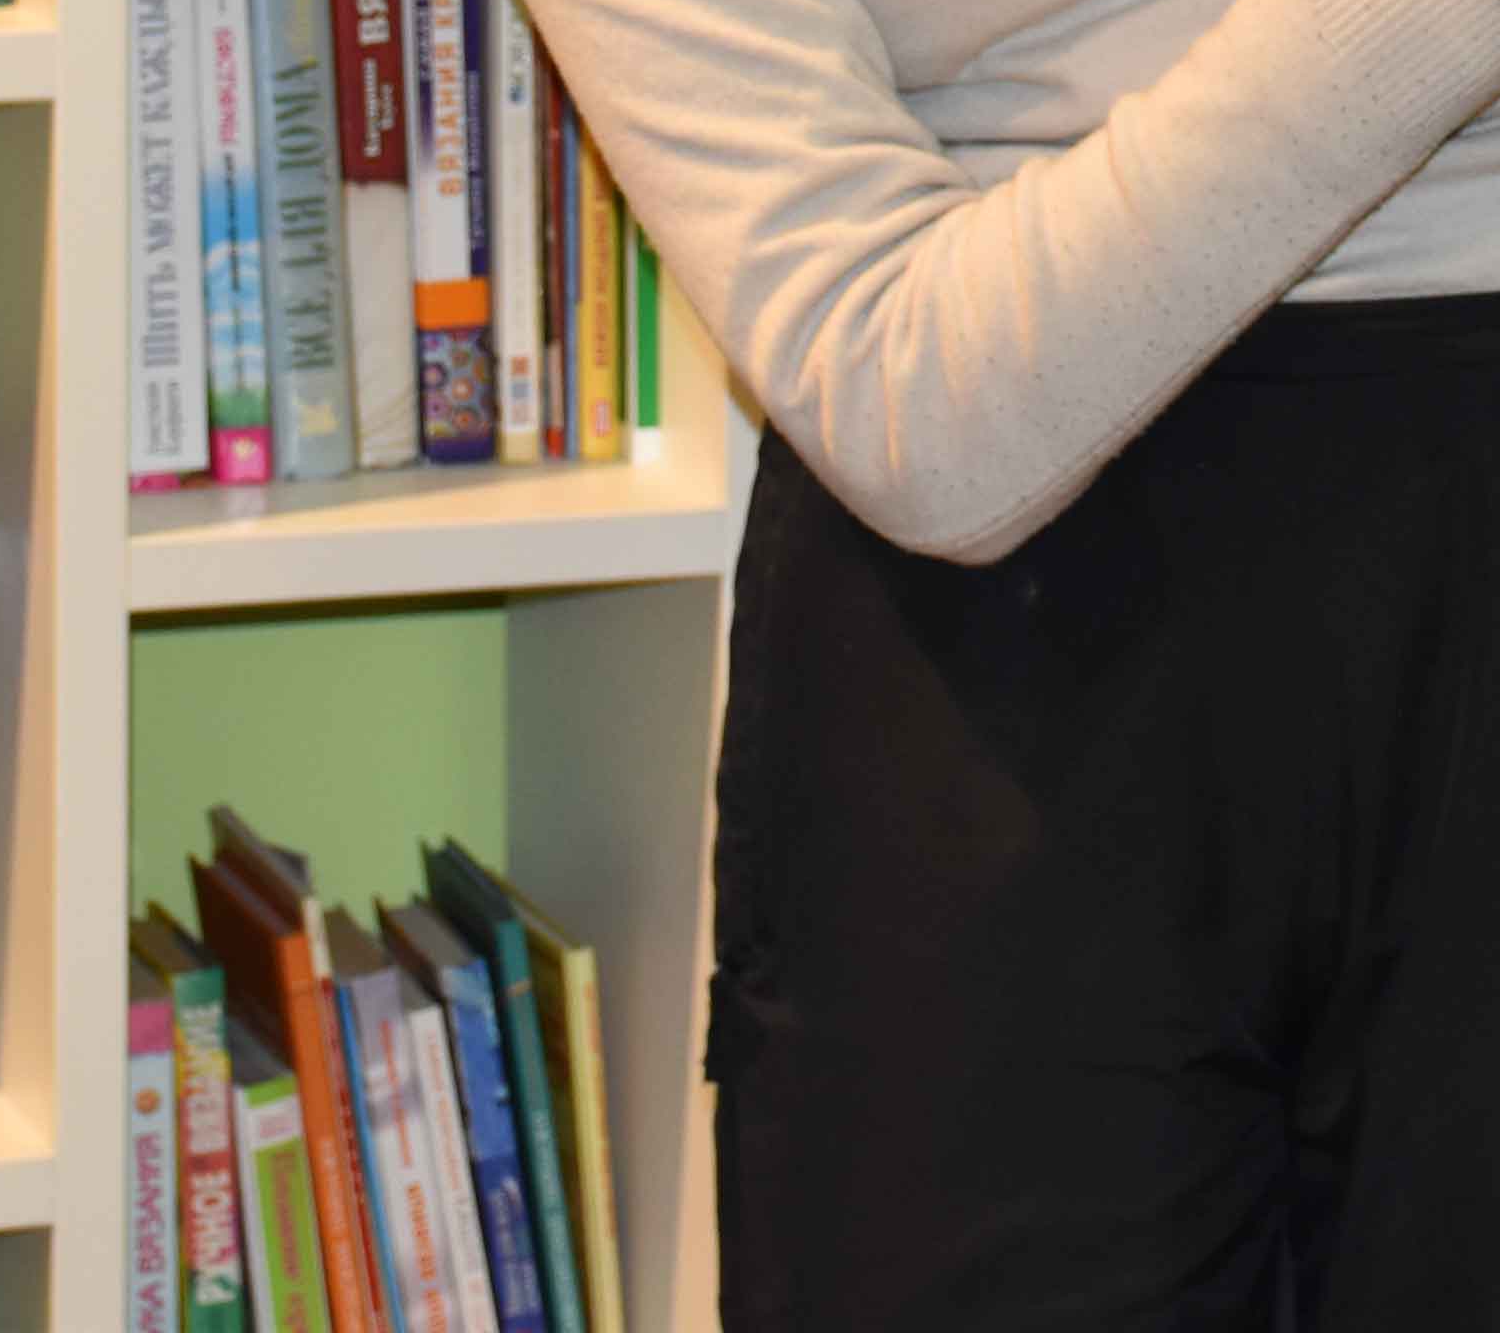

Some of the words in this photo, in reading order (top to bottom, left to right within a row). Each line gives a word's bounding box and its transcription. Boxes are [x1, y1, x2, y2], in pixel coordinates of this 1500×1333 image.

[272, 58, 329, 185] ДОМА
[435, 43, 464, 198] ВЯЗАНИЯ
[281, 194, 333, 282] ДЛЯ
[288, 284, 338, 372] ВСЕ
[133, 1133, 165, 1275] ВЯЗАНИЯ
